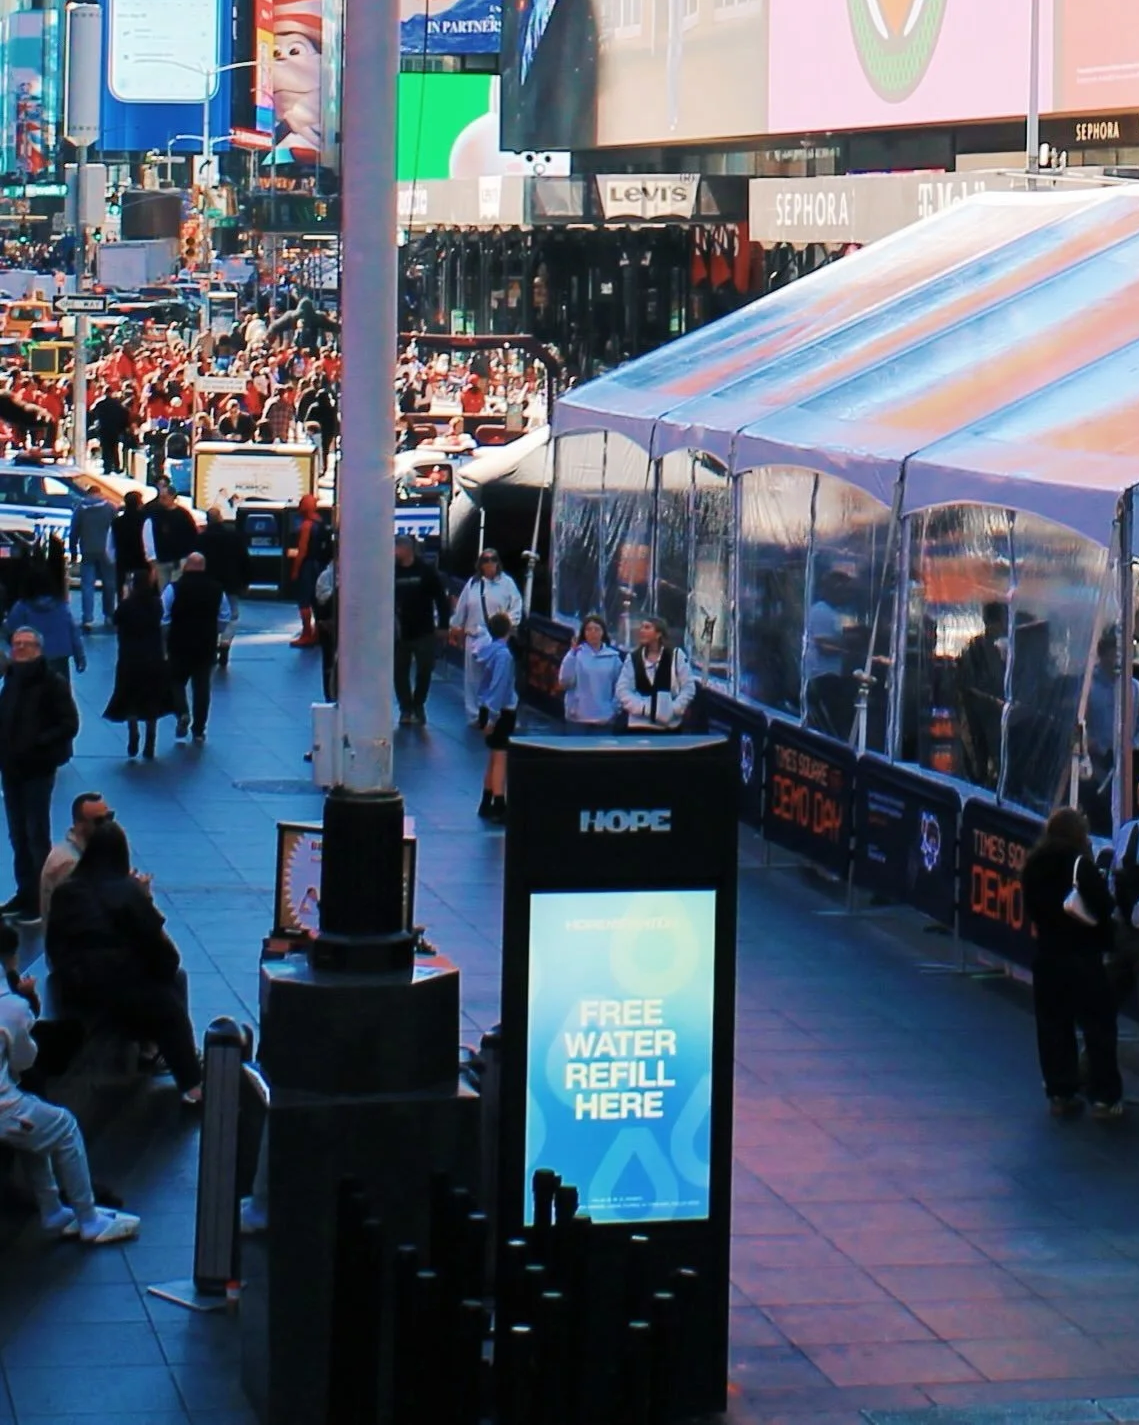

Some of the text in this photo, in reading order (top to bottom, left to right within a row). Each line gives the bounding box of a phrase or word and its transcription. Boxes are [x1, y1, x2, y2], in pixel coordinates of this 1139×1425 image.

[428, 20, 440, 34] IN
[1076, 122, 1120, 142] SEPHORA
[775, 188, 850, 226] SEPHORA
[580, 809, 672, 833] HOPE
[771, 774, 810, 827] DEMO
[813, 792, 843, 843] DAY
[973, 828, 1005, 866] TIMES
[972, 864, 1024, 930] DEMO
[580, 1000, 663, 1027] FREE
[564, 1031, 677, 1058] WATER
[564, 1062, 676, 1089] REFILL
[574, 1092, 664, 1120] HERE
